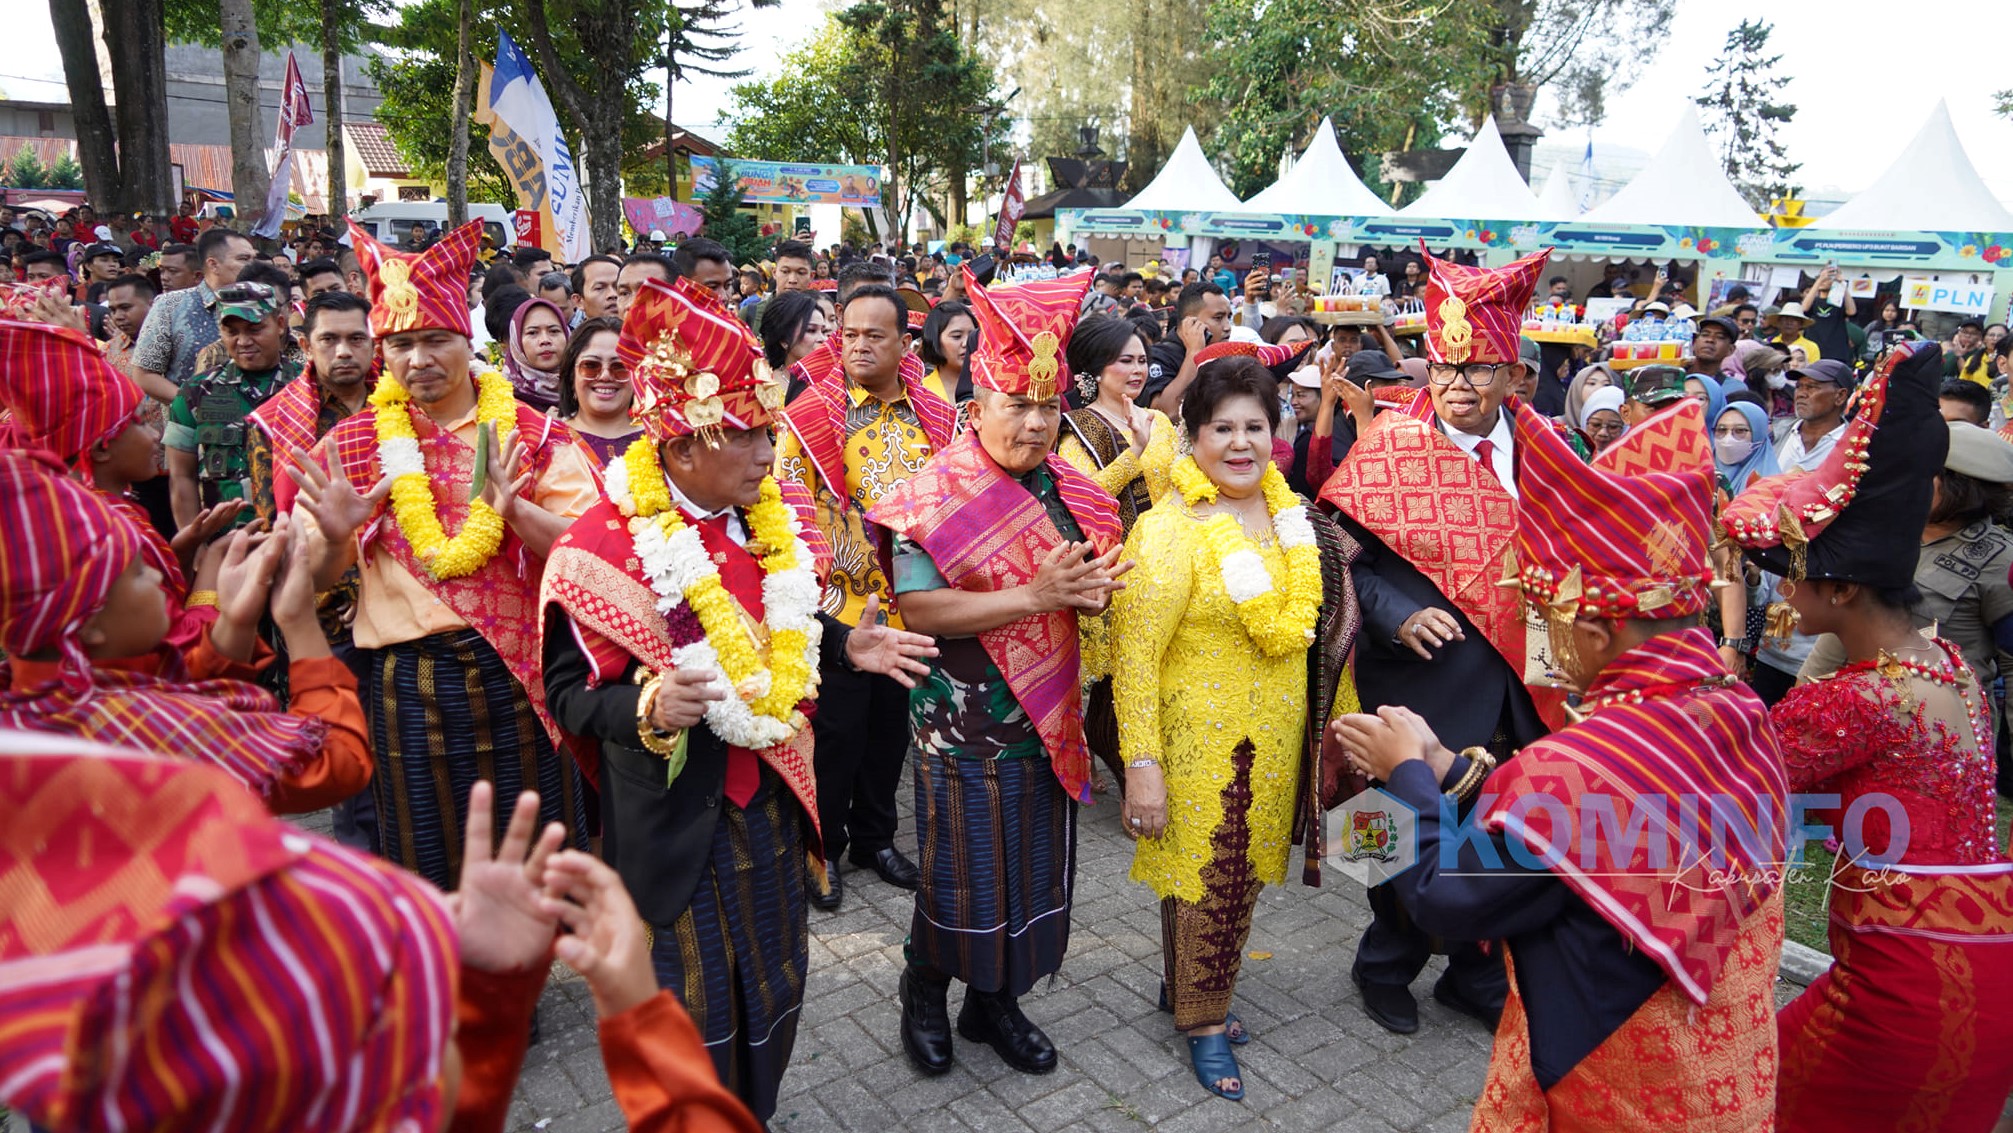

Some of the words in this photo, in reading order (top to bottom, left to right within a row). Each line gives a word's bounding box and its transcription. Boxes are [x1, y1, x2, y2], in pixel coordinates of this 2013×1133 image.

[1933, 288, 1984, 307] PLN
[1938, 556, 1956, 569] POL
[1961, 566, 1976, 577] PP
